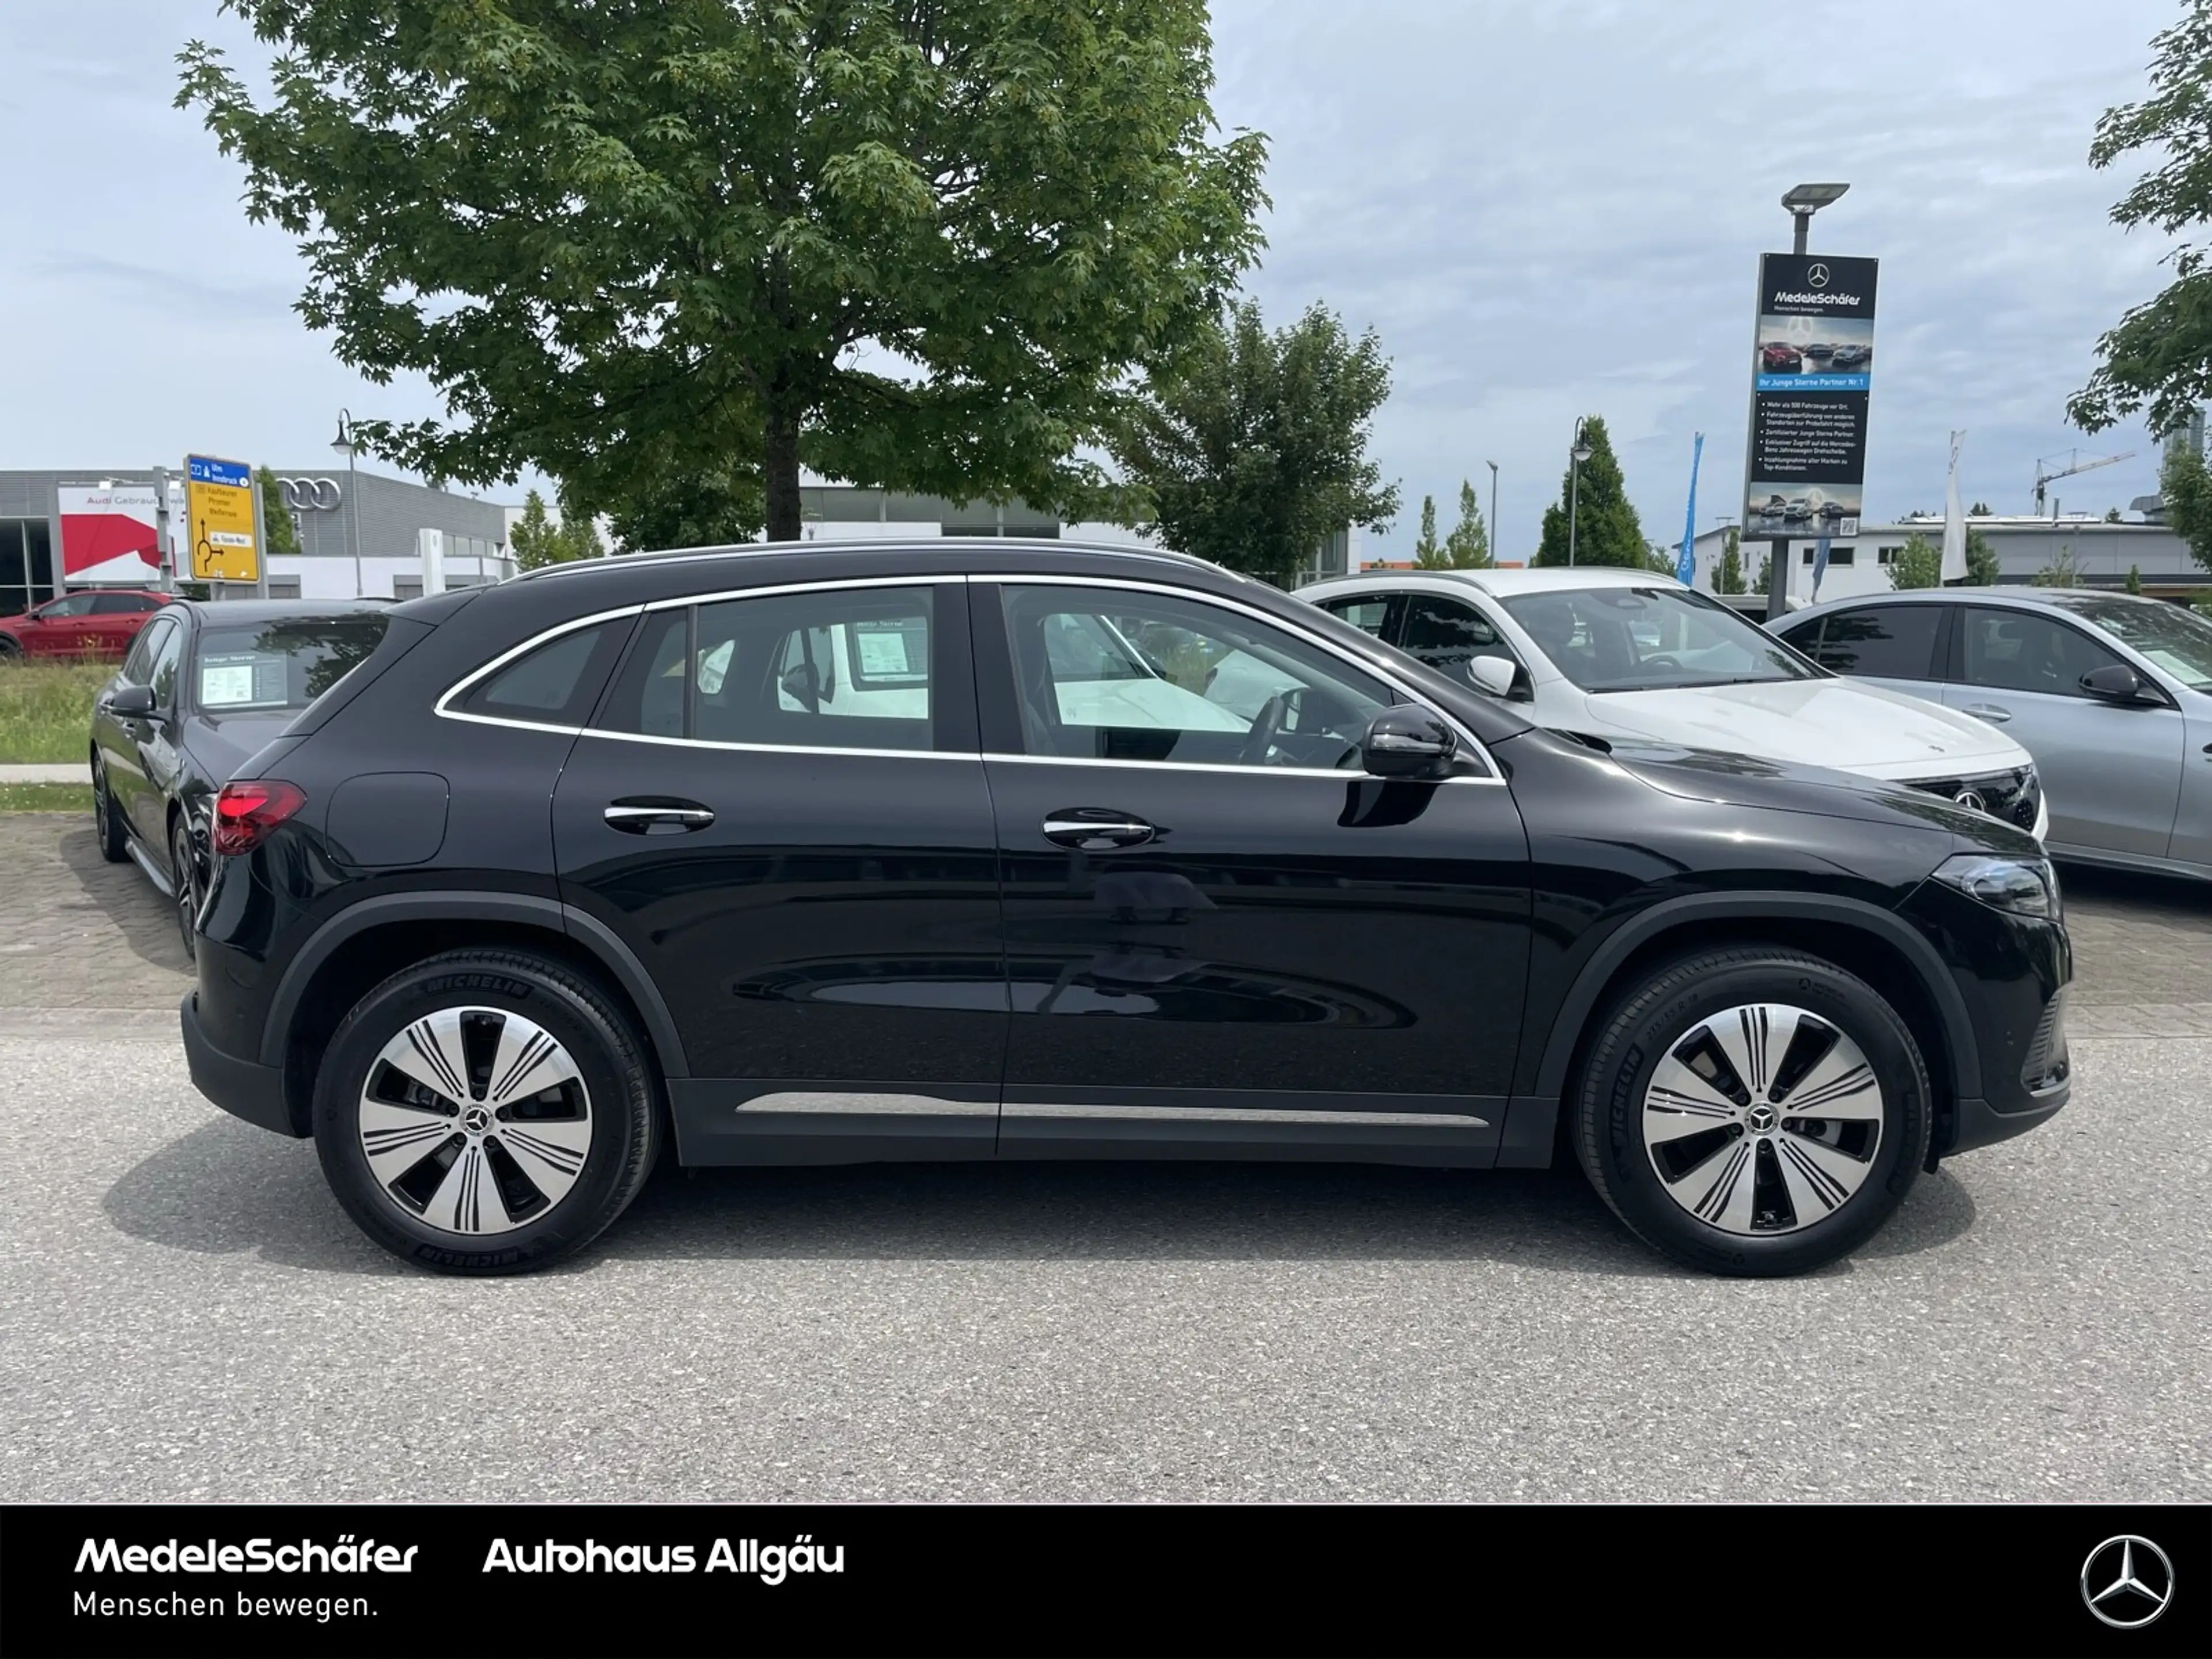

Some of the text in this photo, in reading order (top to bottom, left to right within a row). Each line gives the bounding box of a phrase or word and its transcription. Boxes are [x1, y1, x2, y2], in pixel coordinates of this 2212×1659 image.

[1774, 291, 1861, 305] MedeleSchäfer
[1759, 378, 1770, 387] Ihr
[1771, 378, 1793, 388] Junge
[1794, 378, 1817, 387] Sterne
[1819, 378, 1847, 387] Partner
[427, 974, 529, 998] MICHELIN
[1612, 1048, 1641, 1147] MICHELIN
